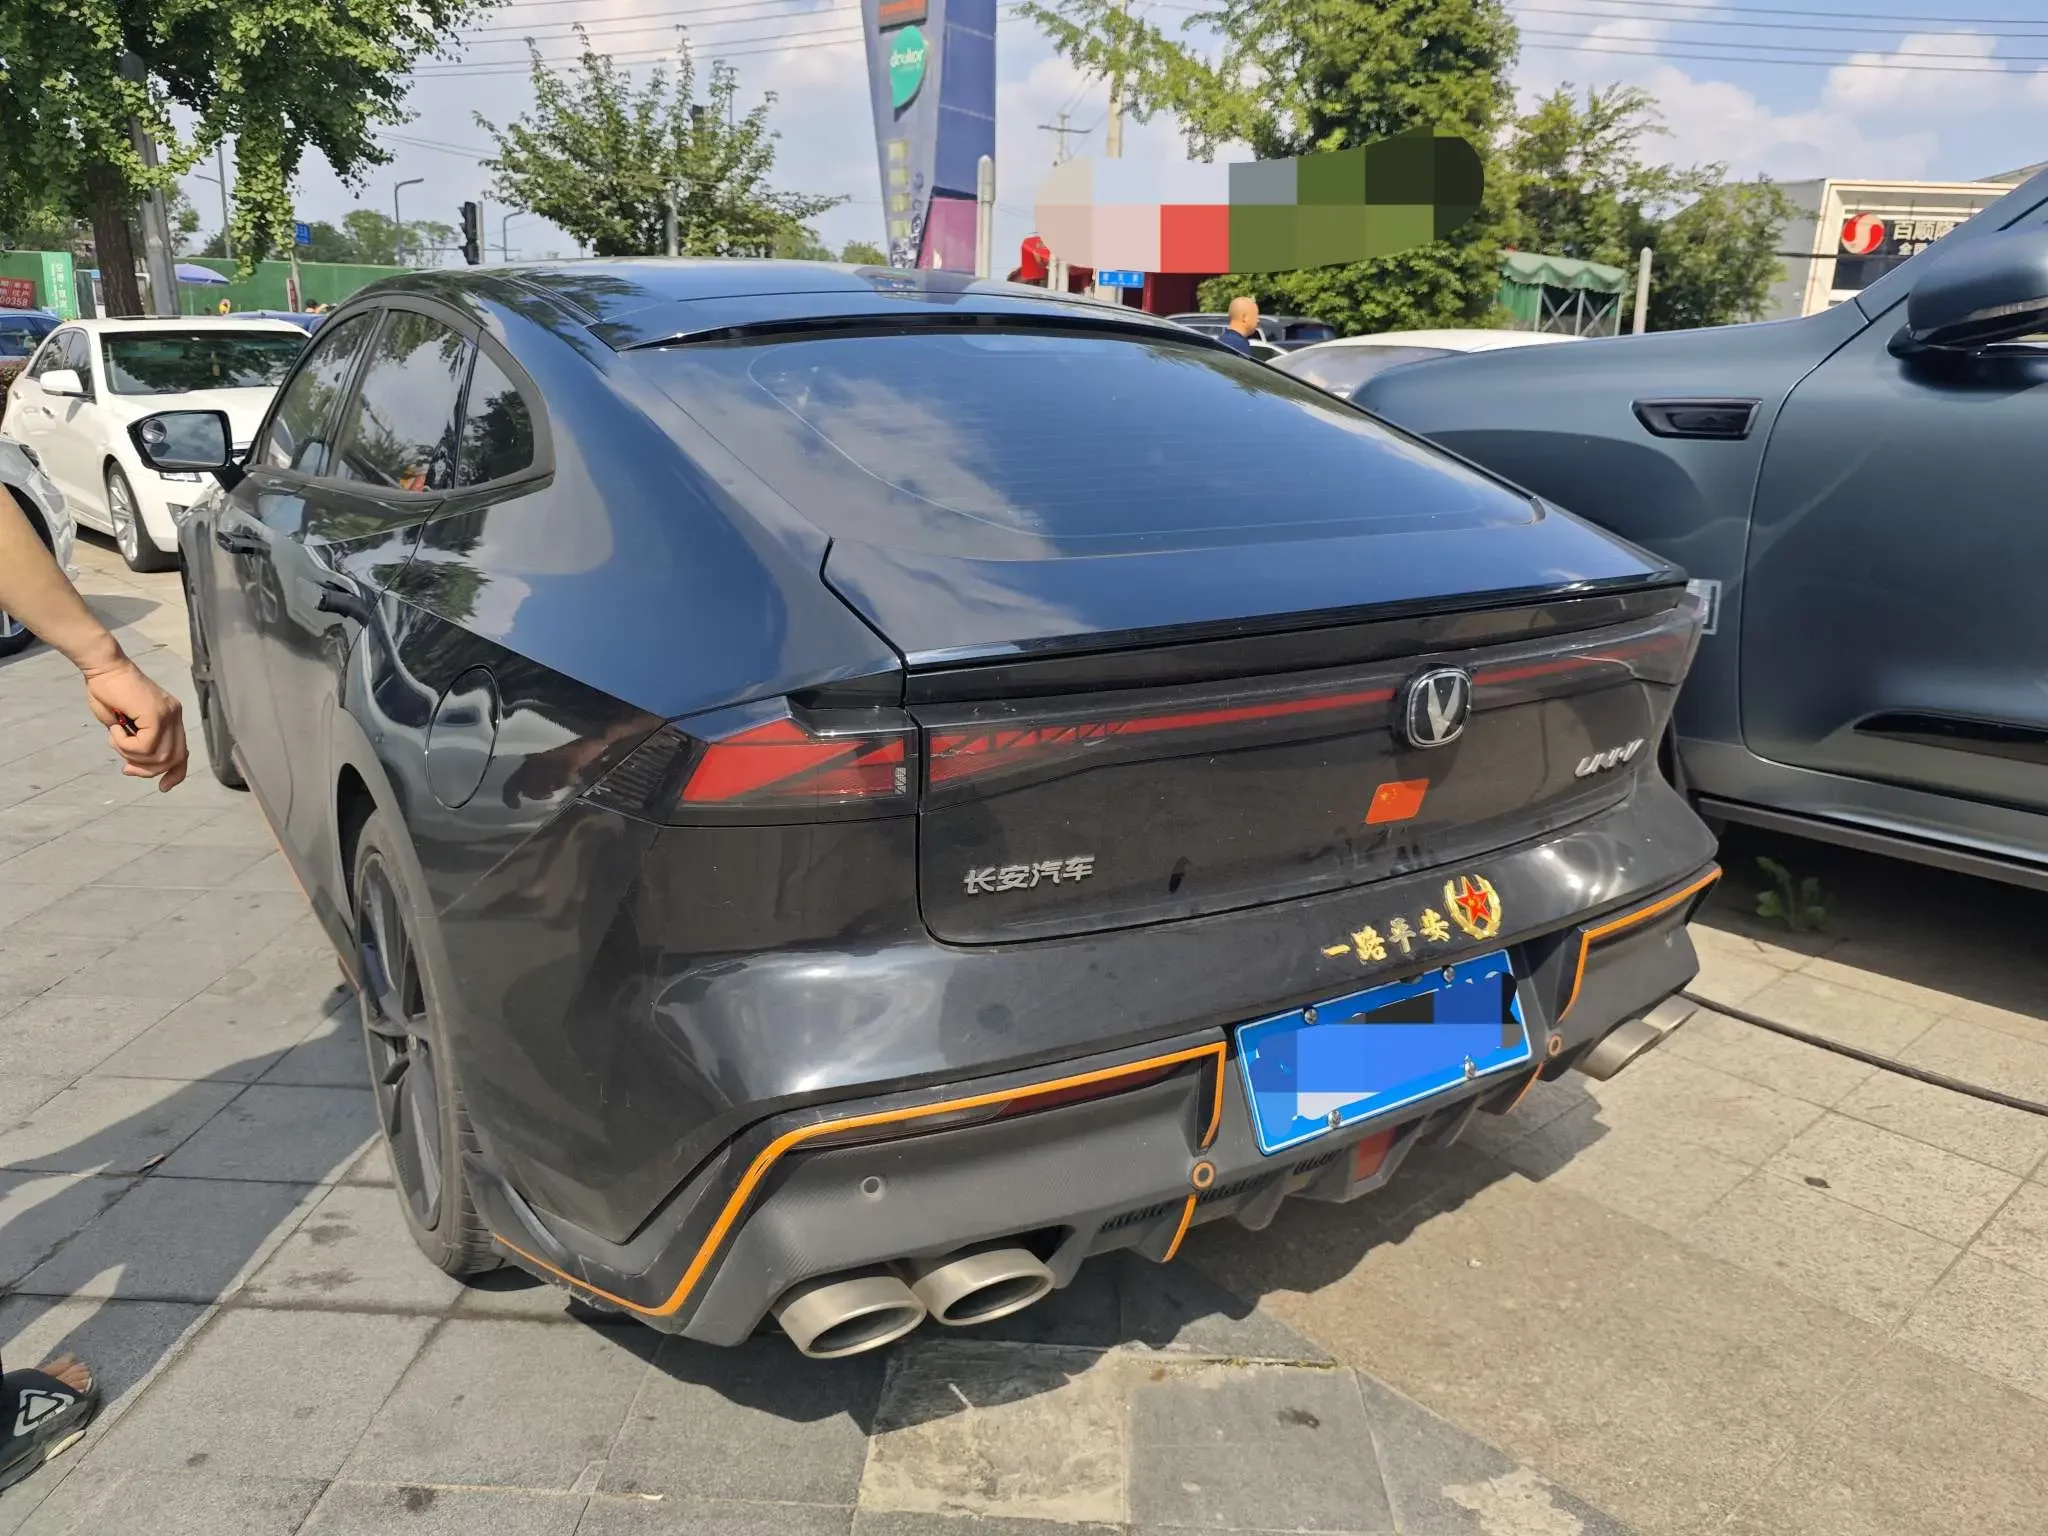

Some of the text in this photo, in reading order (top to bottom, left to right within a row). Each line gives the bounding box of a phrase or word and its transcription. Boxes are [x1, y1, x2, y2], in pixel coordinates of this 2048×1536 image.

[963, 856, 1095, 894] 长安汽车
[1321, 908, 1450, 963] 一路平安
